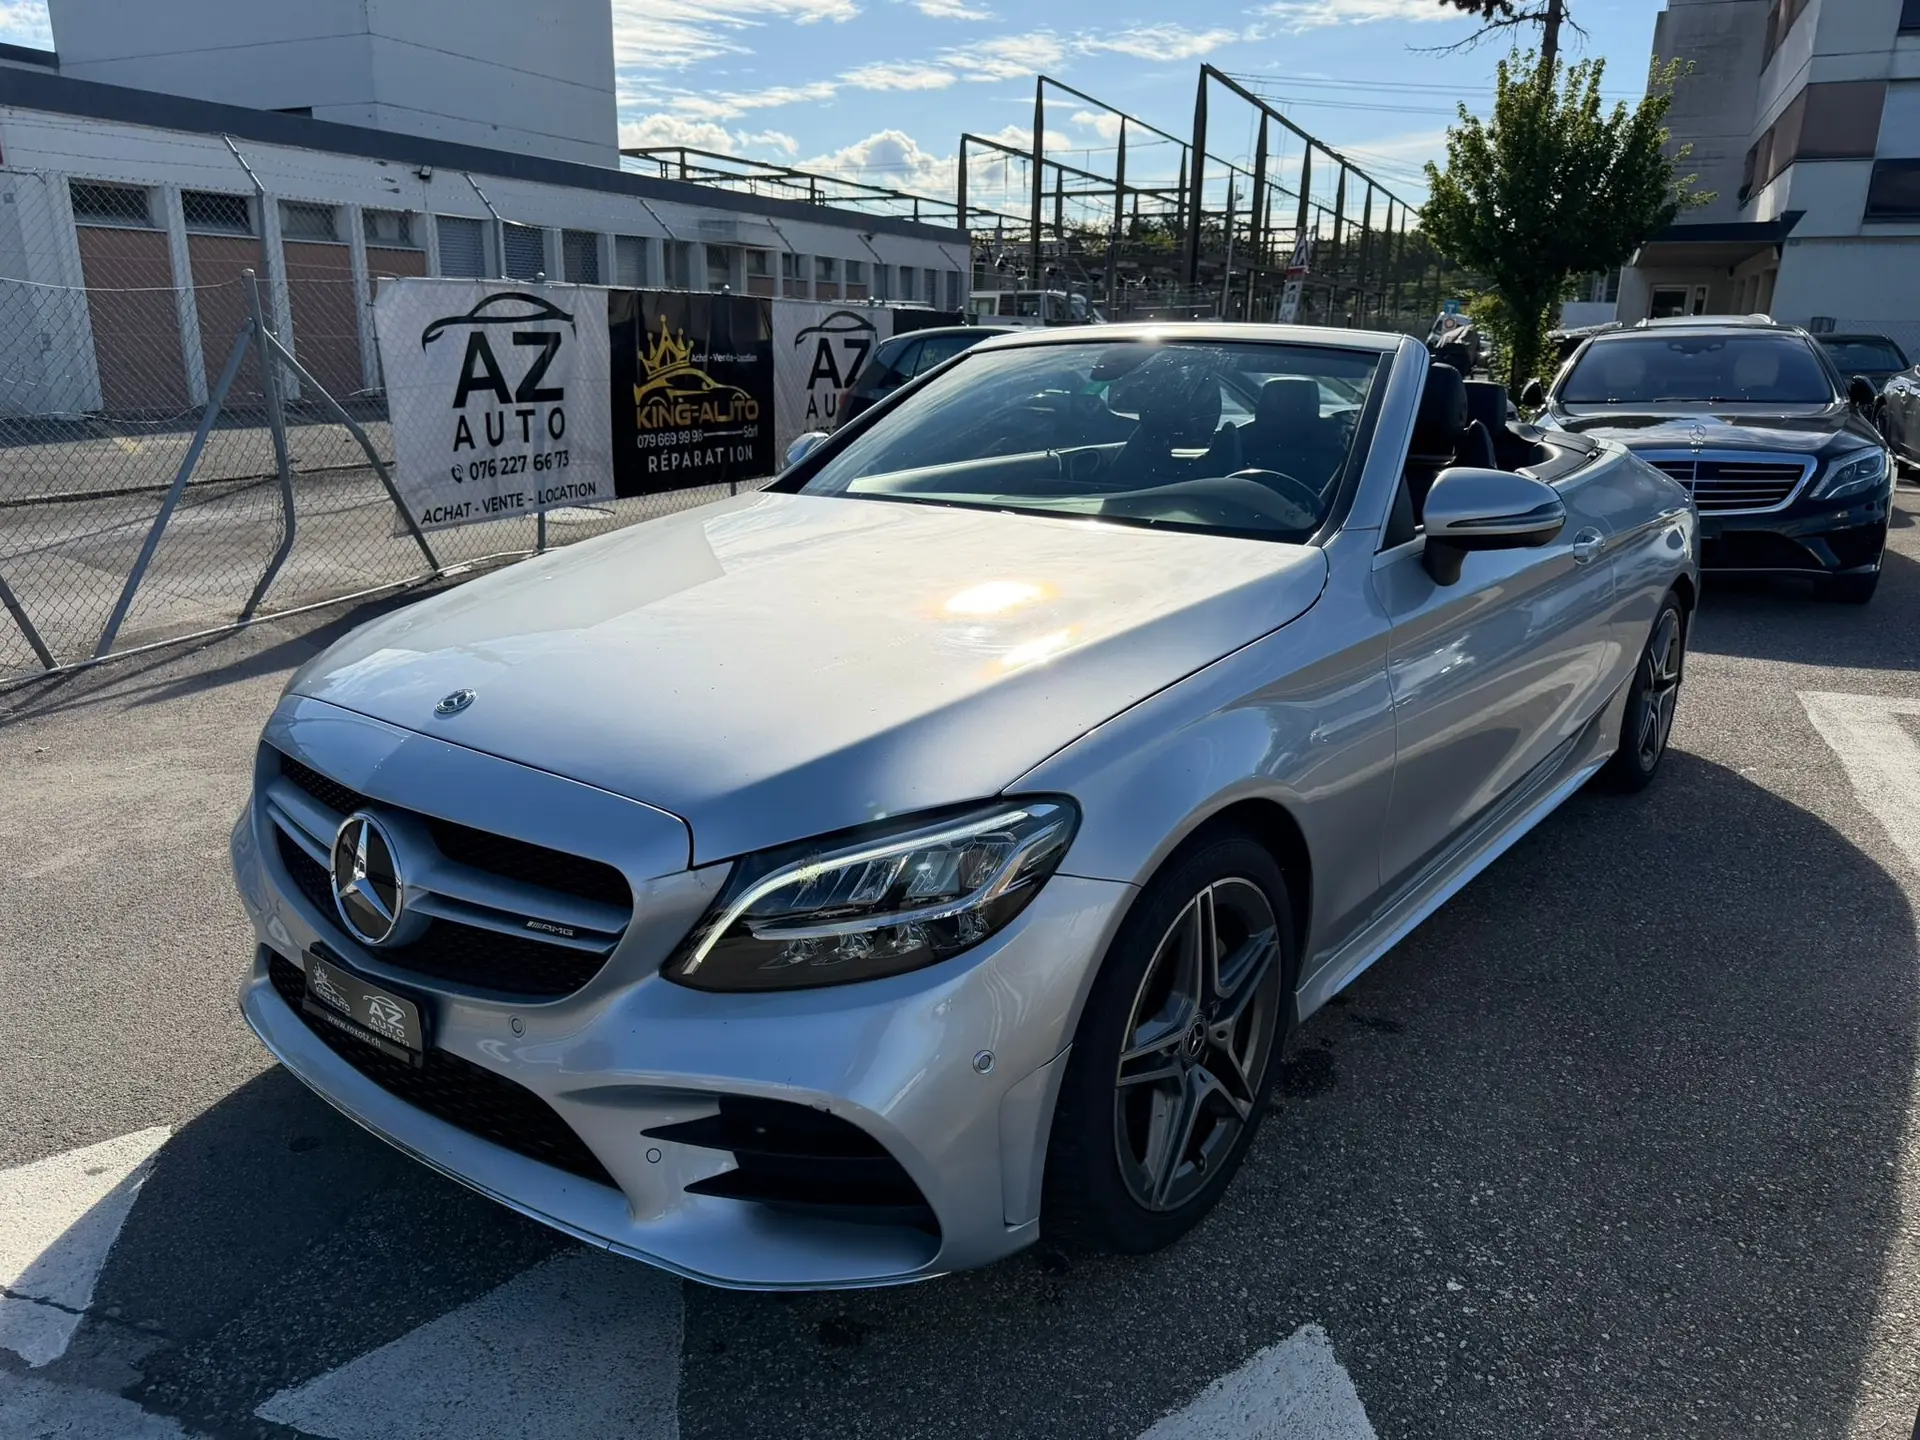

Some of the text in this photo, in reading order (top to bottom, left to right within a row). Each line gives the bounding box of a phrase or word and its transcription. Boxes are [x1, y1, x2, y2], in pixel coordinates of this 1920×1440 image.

[452, 331, 564, 409] AZ
[807, 338, 871, 390] AZ
[806, 393, 836, 420] AU
[453, 407, 566, 452] AUTO
[637, 434, 656, 449] 079
[657, 432, 677, 447] 669
[678, 431, 691, 444] 99
[469, 450, 570, 481] 076 227 66 73
[648, 445, 753, 473] RÉPARATION
[421, 502, 471, 525] ACHAT
[482, 492, 524, 514] VENTE
[538, 481, 597, 505] LOCATION
[369, 1001, 405, 1030] AZ
[370, 1016, 405, 1038] AUTO
